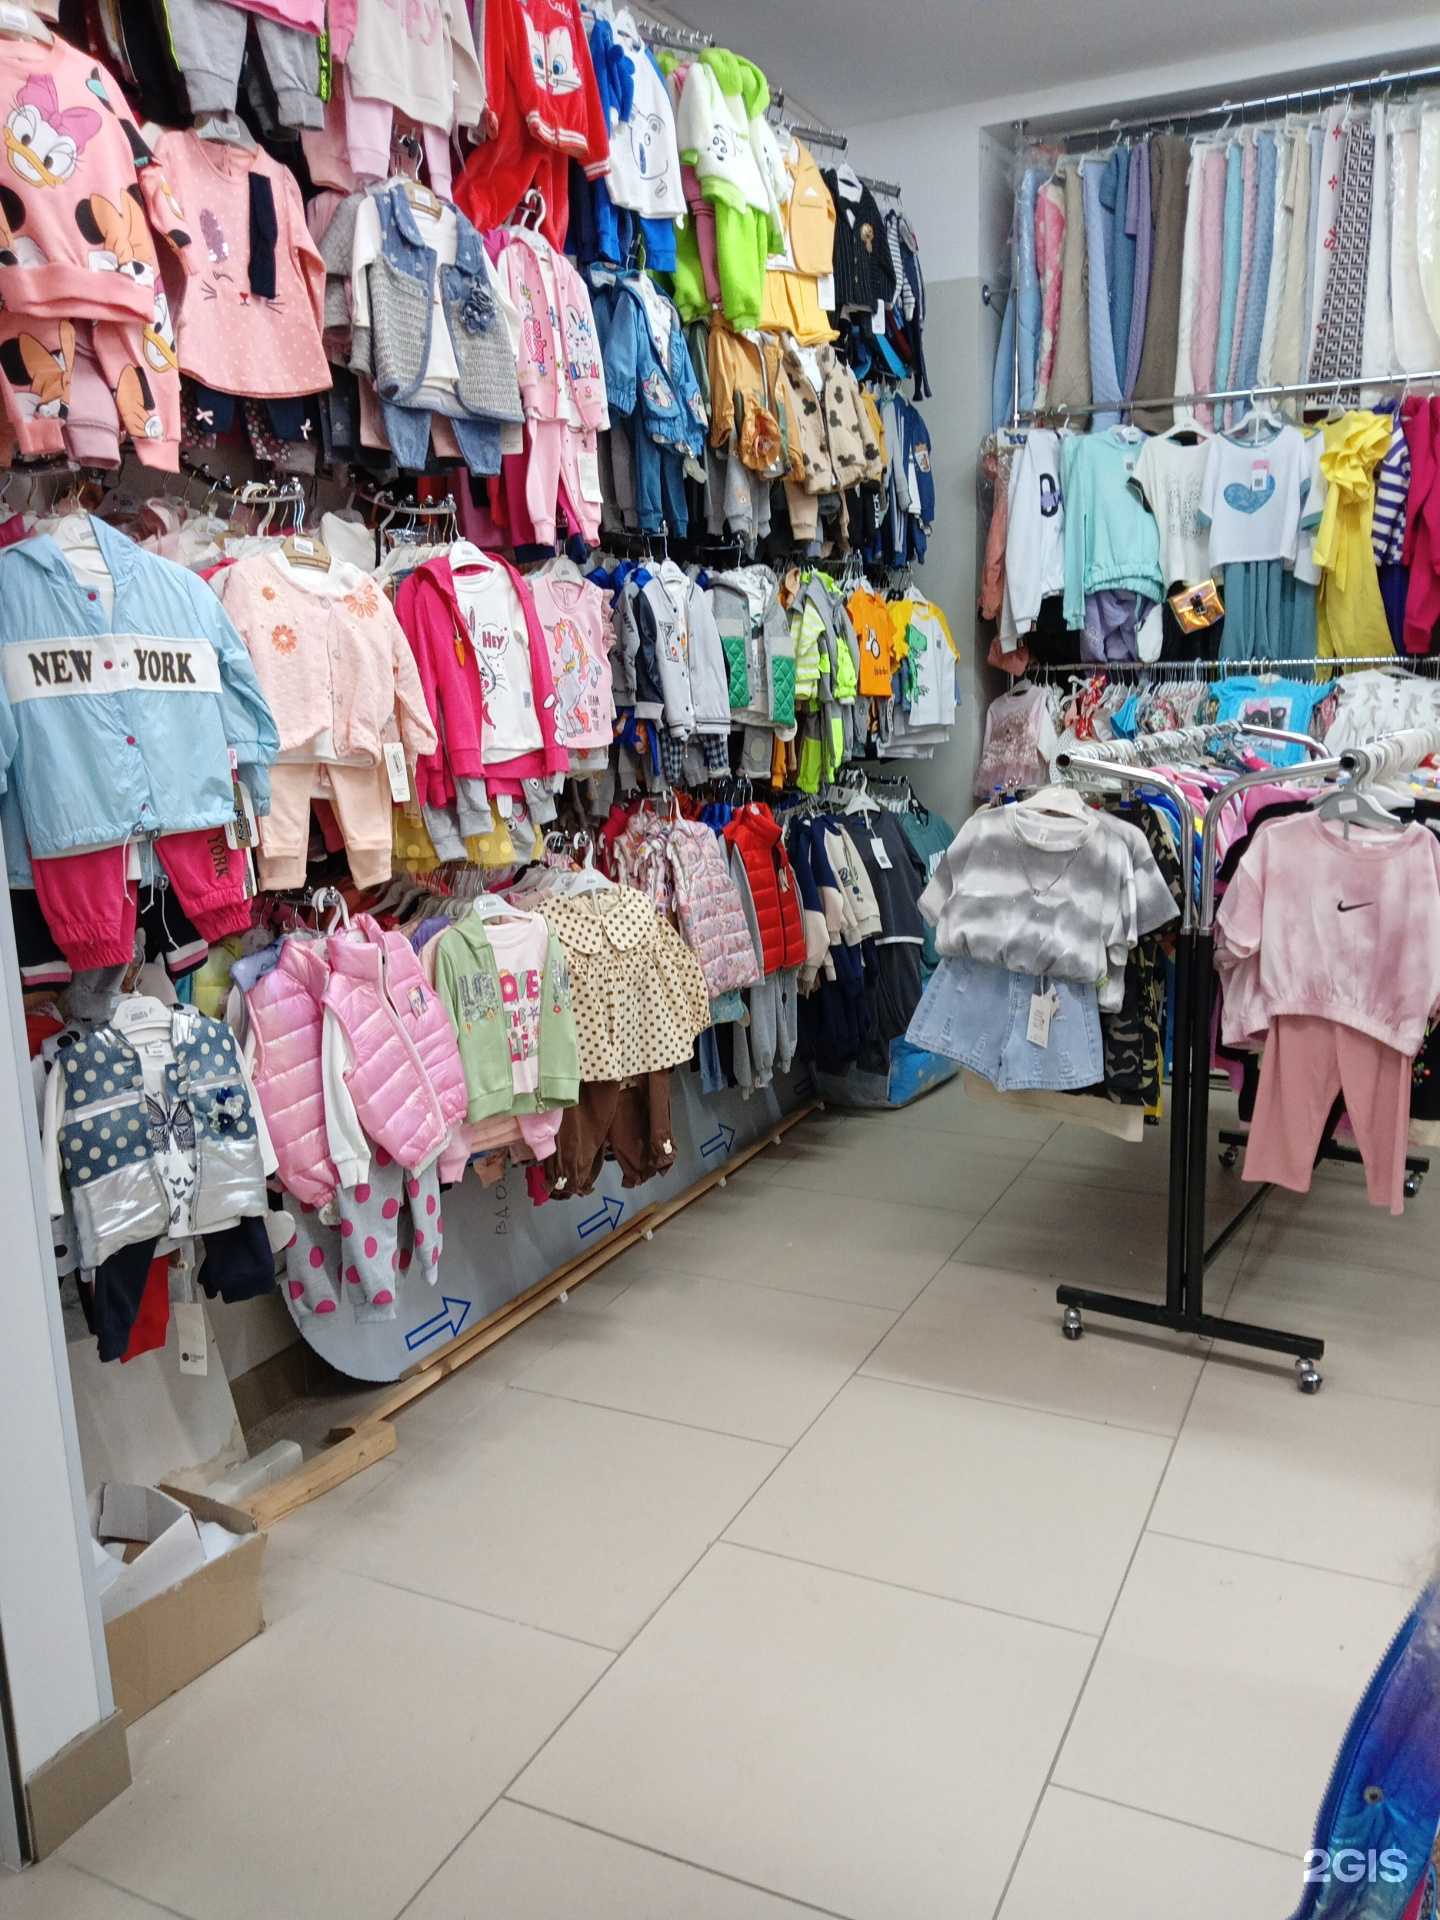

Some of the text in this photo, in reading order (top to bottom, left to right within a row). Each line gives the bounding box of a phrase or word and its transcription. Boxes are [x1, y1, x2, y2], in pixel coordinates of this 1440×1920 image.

[28, 649, 196, 686] NEW YORK
[207, 833, 230, 879] YORK
